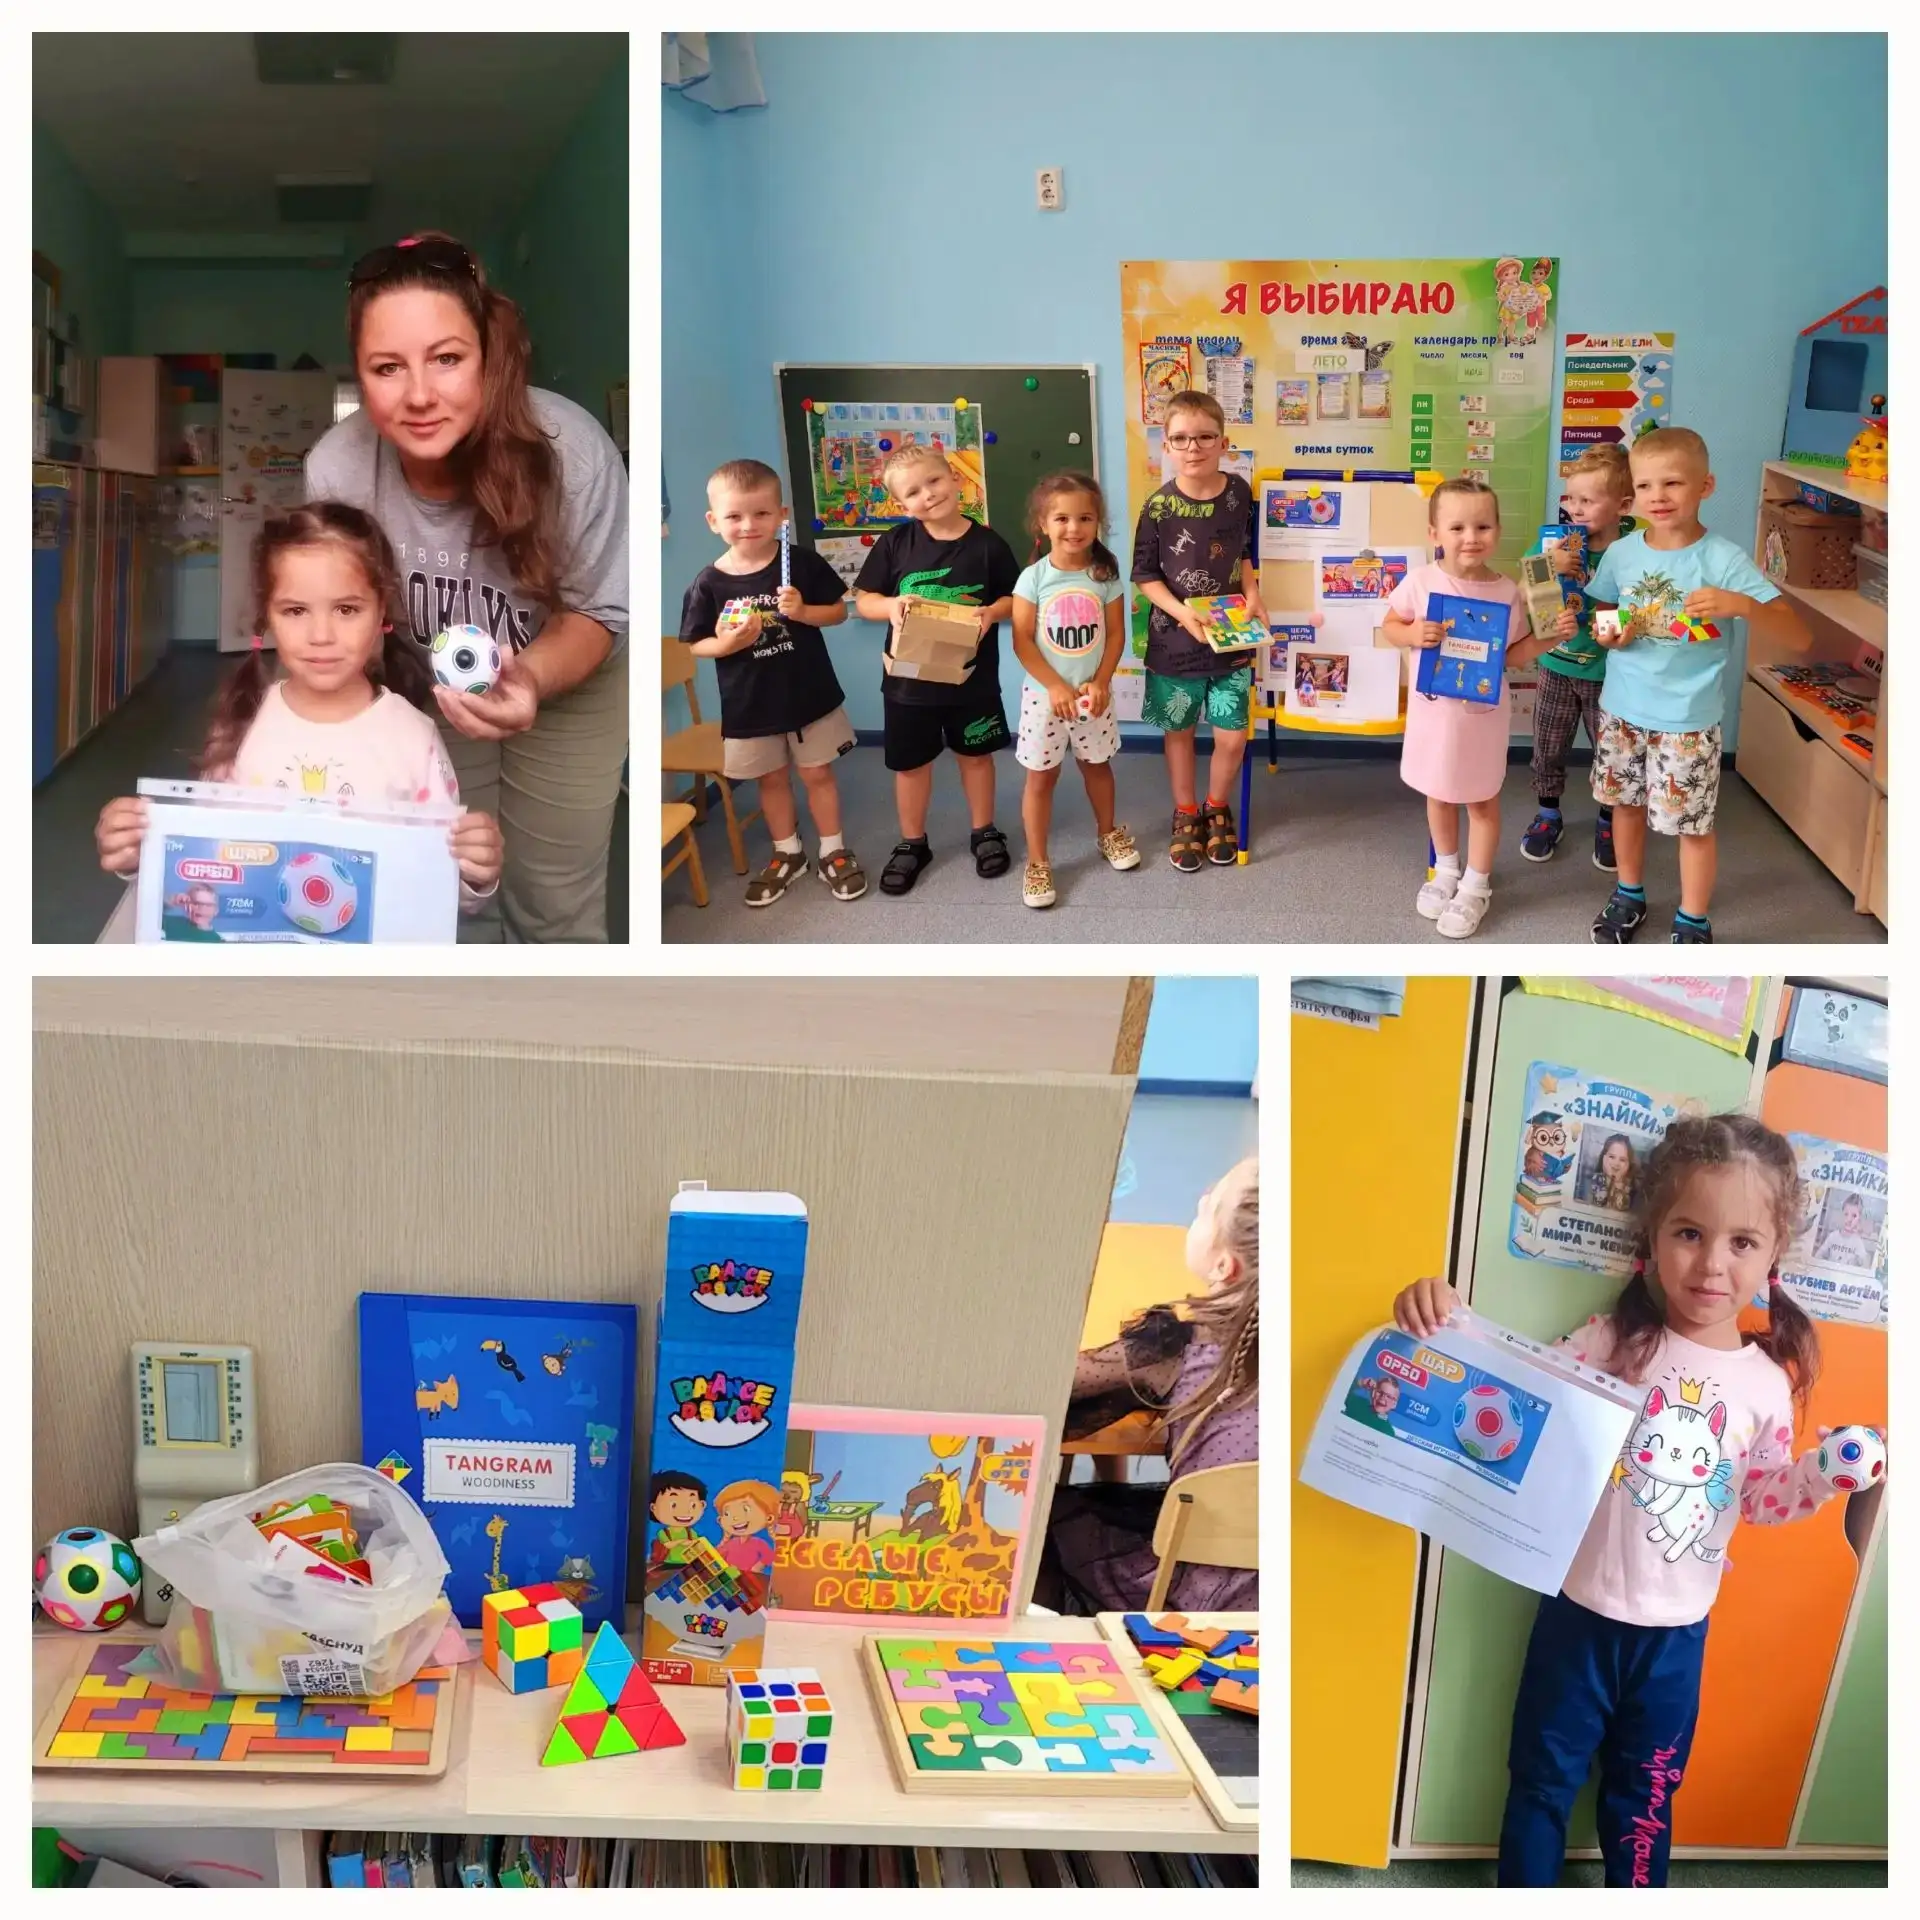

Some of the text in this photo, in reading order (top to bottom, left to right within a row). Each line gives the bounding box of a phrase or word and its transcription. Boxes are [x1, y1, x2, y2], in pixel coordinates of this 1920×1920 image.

[1221, 281, 1456, 316] Я ВЫБИРАЮ
[1301, 336, 1338, 347] время
[1414, 336, 1478, 347] календарь
[1585, 338, 1653, 348] ДНИ НЕДЕЛИ
[1312, 355, 1348, 368] ЛЕТО
[1420, 352, 1445, 360] число
[1460, 352, 1489, 361] месяц
[1567, 361, 1629, 370] Понедельник
[1567, 379, 1605, 388] Вторник
[1566, 396, 1594, 405] Среда
[1564, 430, 1602, 440] Пятница
[1294, 445, 1374, 456] время суток
[753, 641, 795, 659] MONSTER
[964, 727, 1003, 746] LACOSTE
[1331, 1004, 1371, 1023] Софья
[1604, 1084, 1638, 1101] ГРУППА
[1563, 1096, 1666, 1136] «ЗНАЙКИ»
[1541, 1227, 1583, 1246] МИРА
[692, 1260, 774, 1286] BALANCE
[1781, 1271, 1837, 1292] СКУБИЕВ
[1839, 1283, 1881, 1300] АРТЁМ
[1382, 1355, 1421, 1382] ОРБО
[1421, 1353, 1458, 1376] ШАР
[671, 1371, 777, 1406] BALANCE
[446, 1454, 553, 1475] TANGRAM
[462, 1476, 536, 1490] WOODINESS
[814, 1576, 1005, 1615] РЕБУСЫ
